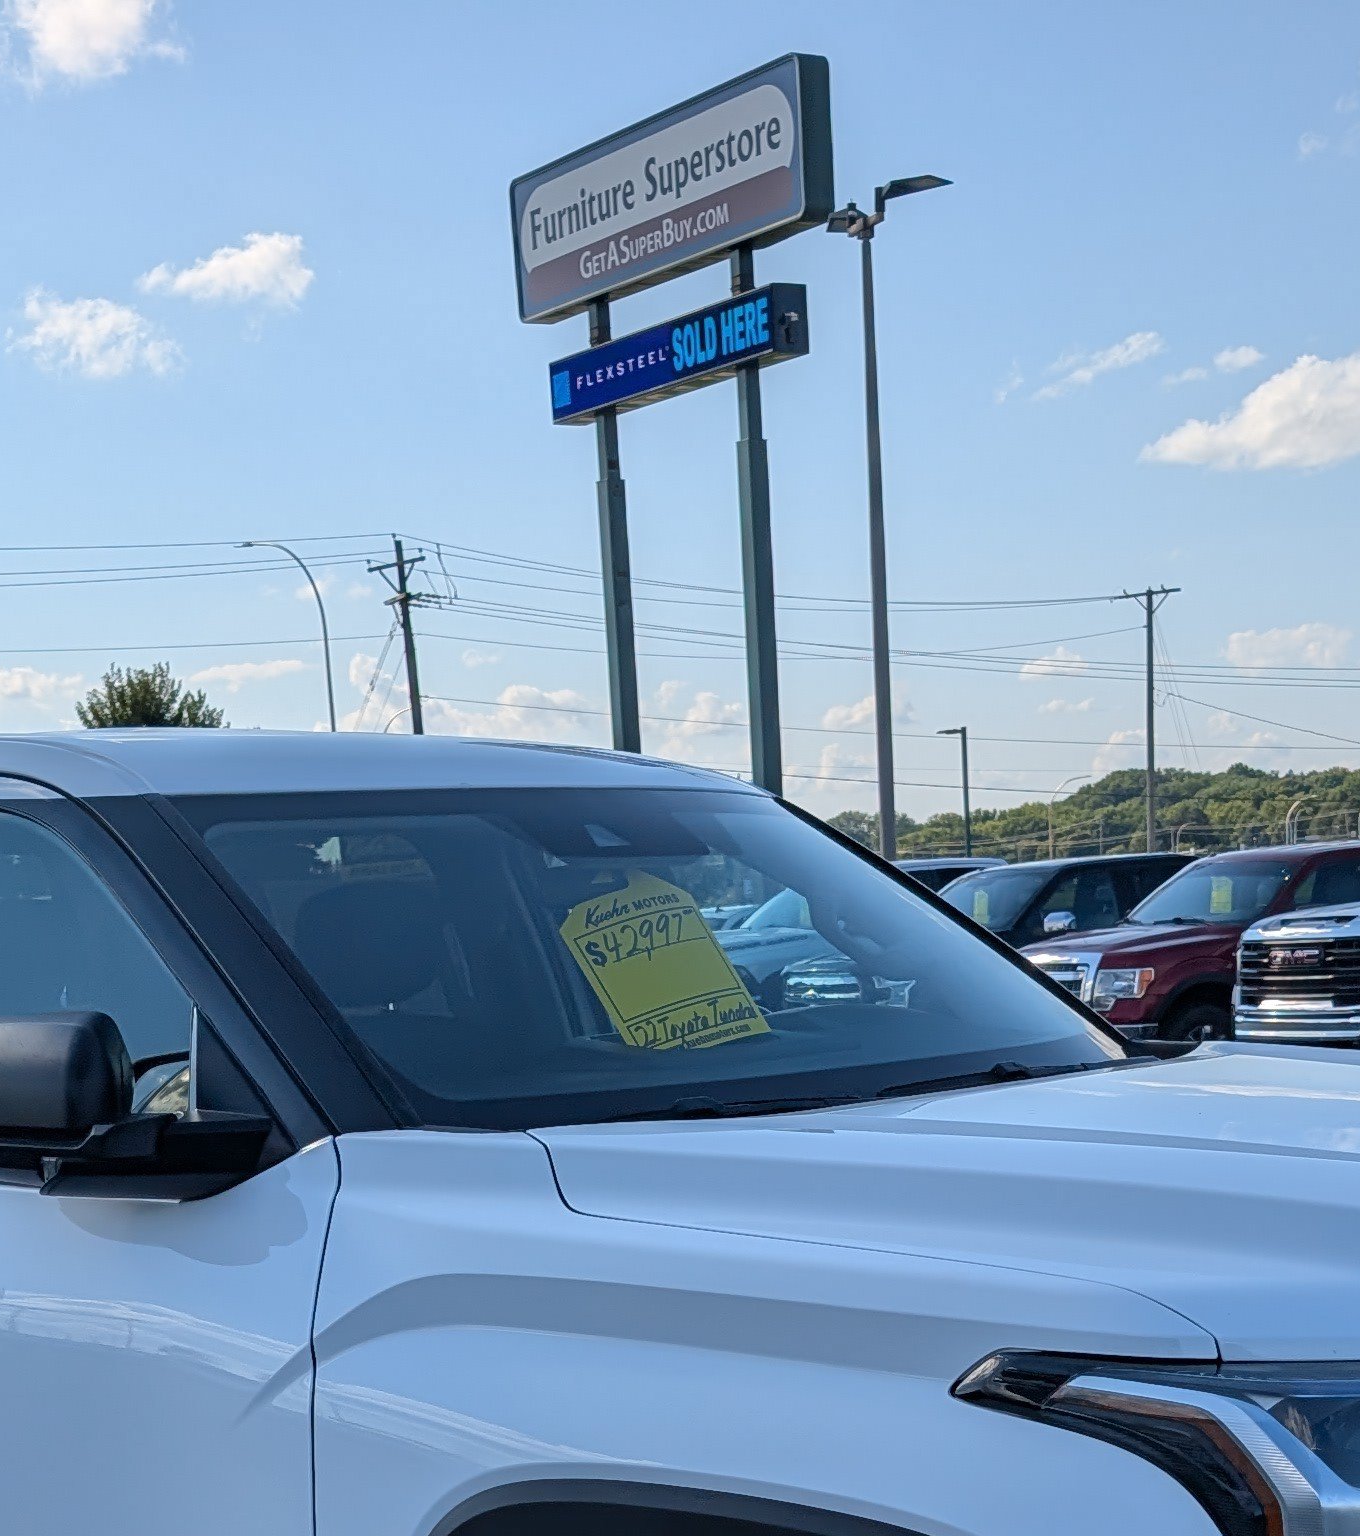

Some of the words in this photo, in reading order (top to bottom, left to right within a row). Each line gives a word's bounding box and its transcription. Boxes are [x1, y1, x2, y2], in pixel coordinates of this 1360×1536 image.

[530, 178, 635, 251] Furniture
[644, 117, 781, 203] Superstore
[577, 349, 667, 390] FLEXSTEEL
[671, 320, 717, 371] SOLD
[721, 297, 770, 357] HERE
[584, 898, 631, 929] Kuehn
[631, 893, 681, 911] MOTORS
[657, 1010, 710, 1047] Toyota
